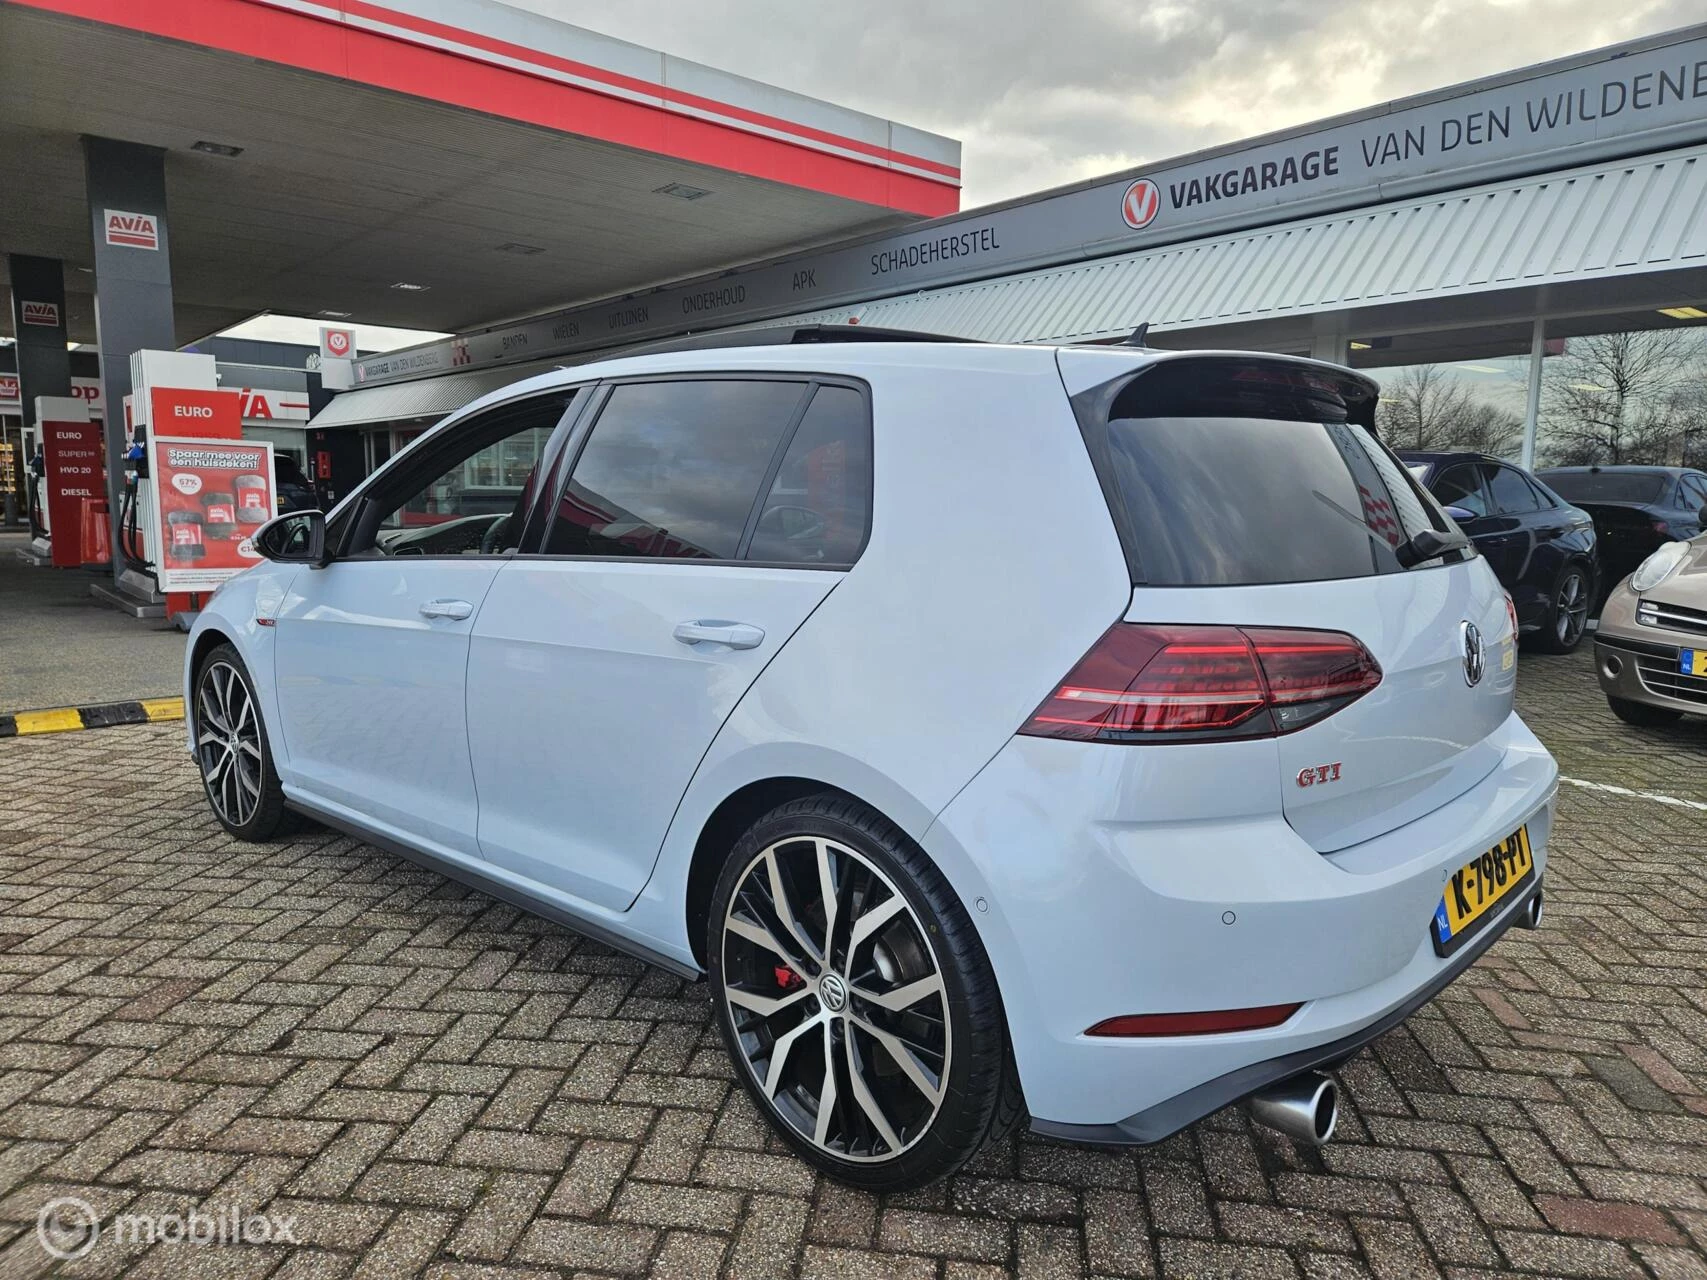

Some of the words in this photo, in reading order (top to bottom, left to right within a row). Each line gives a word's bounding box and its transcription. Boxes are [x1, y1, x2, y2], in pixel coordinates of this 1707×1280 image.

[1170, 146, 1339, 209] VAKGARAGE
[1361, 125, 1425, 167] VAN
[1441, 106, 1510, 151] DEN
[871, 227, 1000, 275] SCHADEHERSTEL
[792, 268, 817, 291] APK
[682, 285, 746, 314] ONDERHOUD
[608, 305, 649, 328] UITLIJNEN
[552, 322, 580, 342] WIELEN
[71, 386, 99, 404] op
[174, 406, 213, 418] EURO
[56, 432, 82, 440] EURO
[58, 450, 87, 458] SUPER
[169, 449, 205, 459] Spaar
[206, 452, 232, 460] mee
[234, 453, 259, 461] voor
[60, 466, 79, 474] HVO
[194, 458, 257, 469] huisdeken!
[61, 488, 92, 496] DIESEL
[1296, 761, 1342, 788] GTI
[1451, 827, 1526, 919] K-798-PT
[1437, 917, 1448, 931] NL
